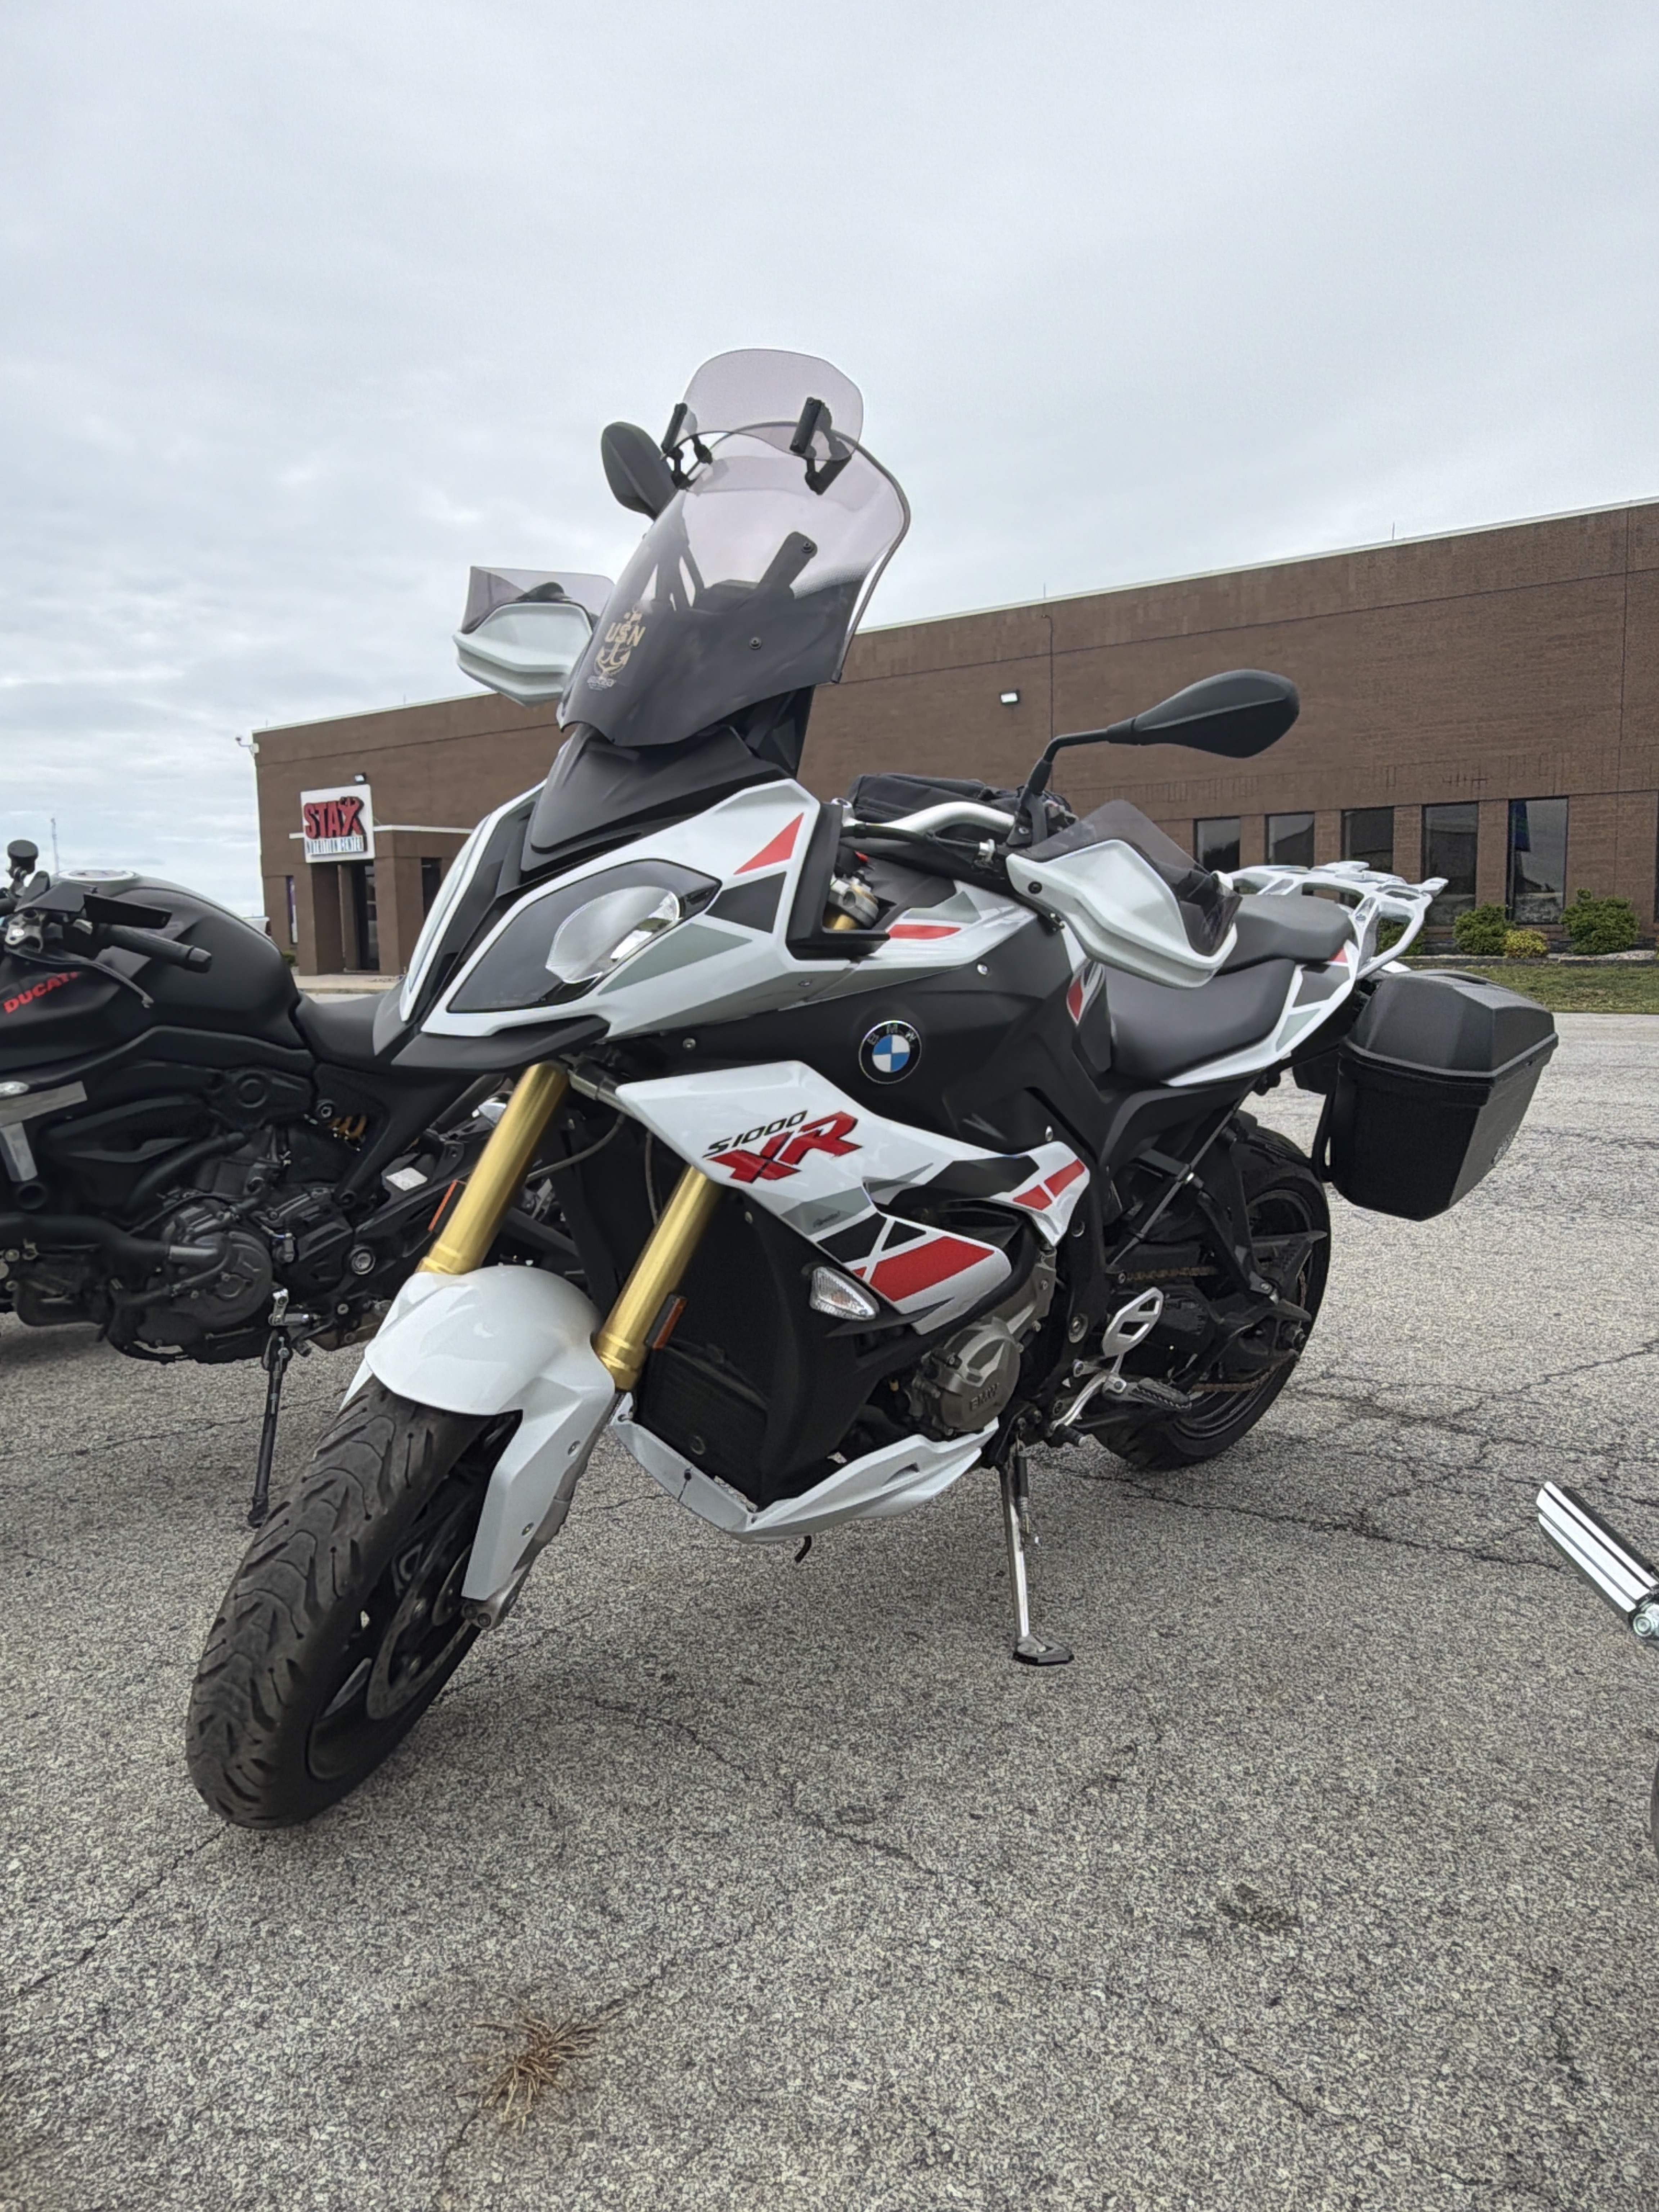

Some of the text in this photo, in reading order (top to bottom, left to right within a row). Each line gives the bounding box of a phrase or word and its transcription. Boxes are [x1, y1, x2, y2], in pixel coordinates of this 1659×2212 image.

[605, 622, 646, 647] USN
[304, 796, 364, 839] STAX
[867, 1024, 917, 1046] BMW
[702, 1109, 808, 1158] S1000
[706, 1111, 863, 1184] XR
[969, 1382, 1000, 1412] BMW
